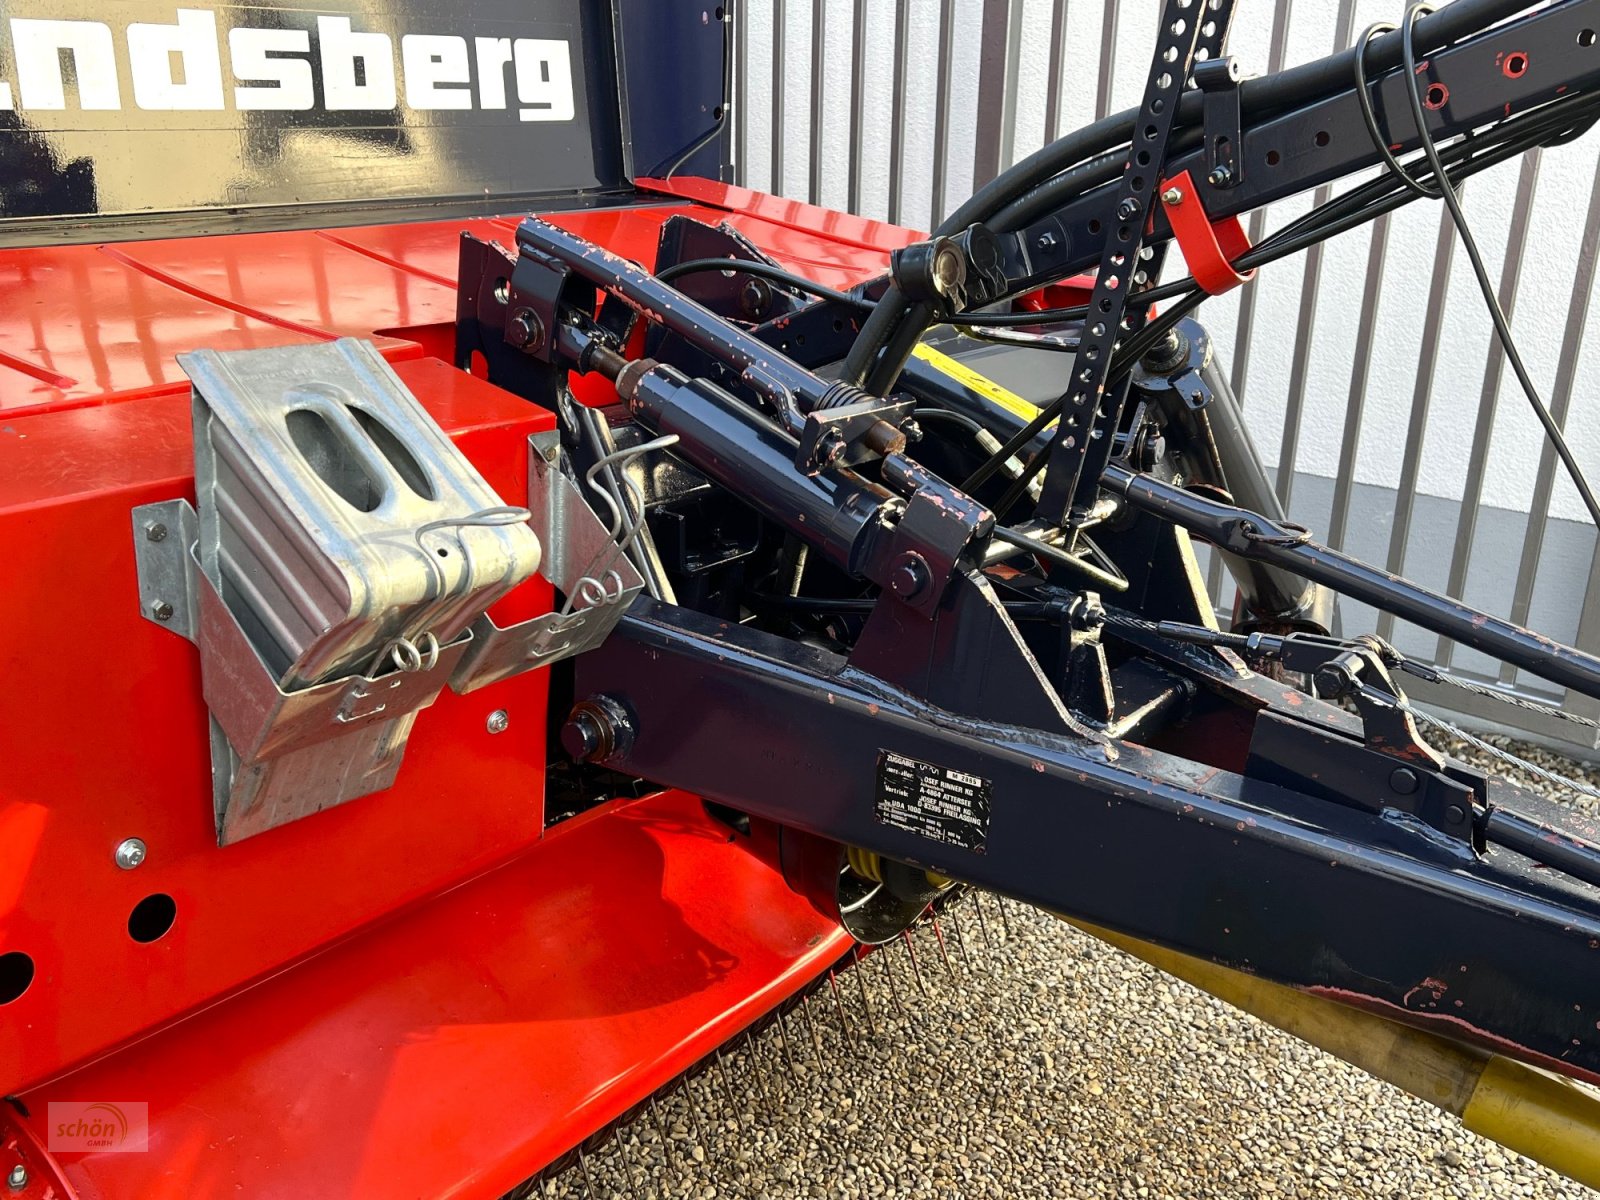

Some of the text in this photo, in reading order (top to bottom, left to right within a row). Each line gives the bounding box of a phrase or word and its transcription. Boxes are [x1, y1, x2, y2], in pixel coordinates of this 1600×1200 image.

[0, 9, 575, 121] ndsberg
[920, 776, 938, 787] OSEF
[941, 781, 962, 794] RINNER
[964, 787, 974, 797] KG
[919, 795, 938, 806] JOSEF
[938, 801, 961, 813] RINNER
[963, 806, 972, 816] KG
[943, 793, 972, 807] ATTERSEE
[943, 808, 981, 826] FREILASSING
